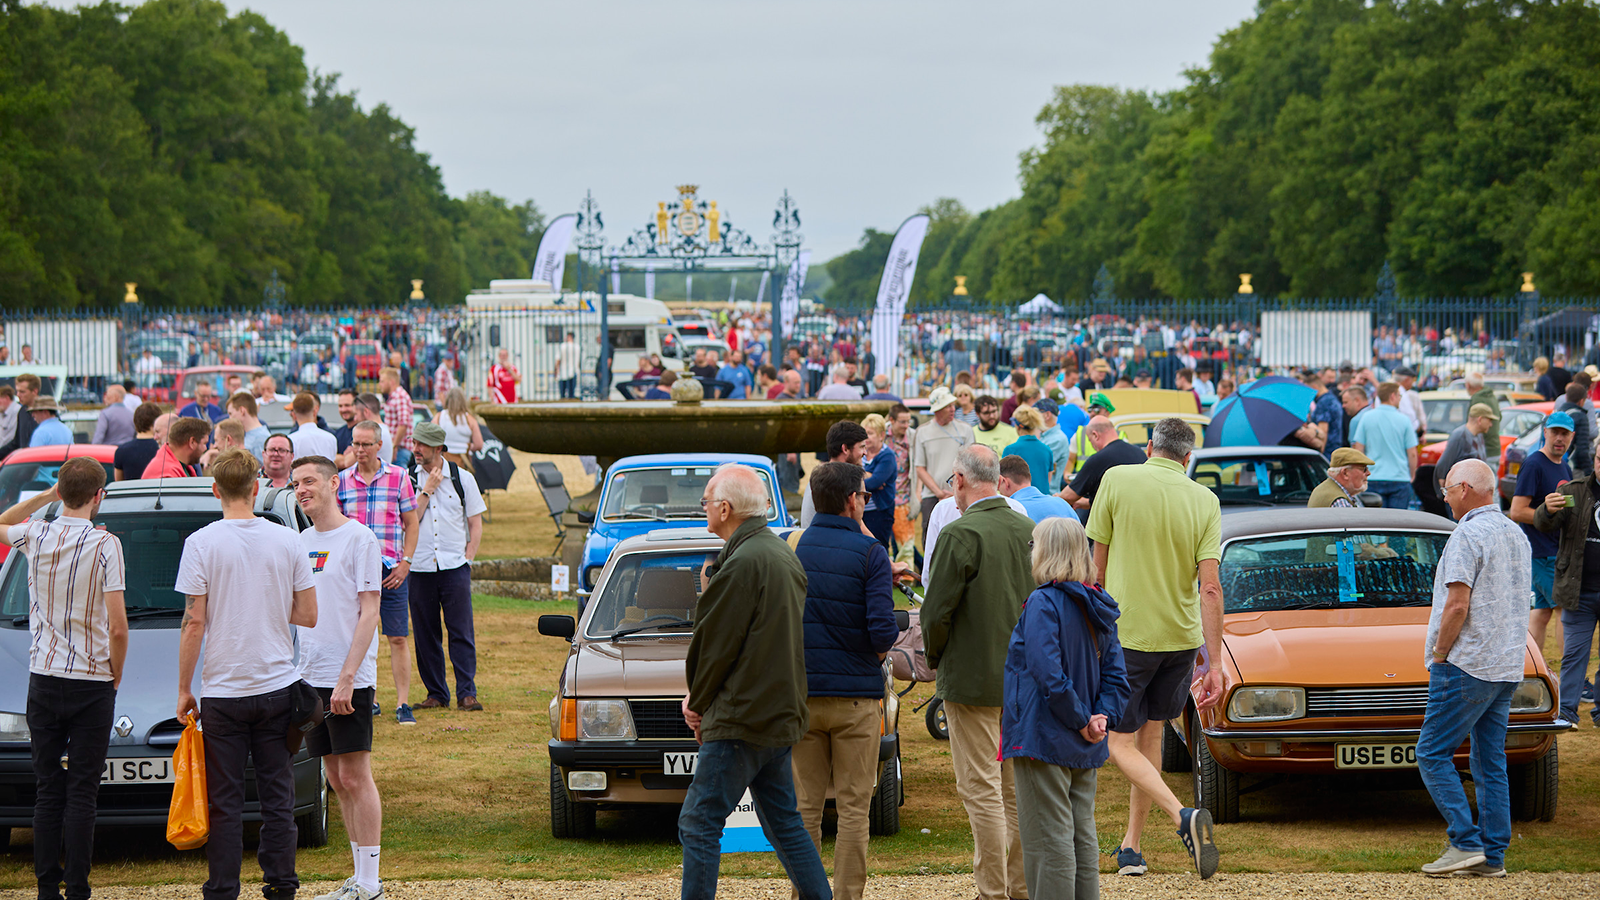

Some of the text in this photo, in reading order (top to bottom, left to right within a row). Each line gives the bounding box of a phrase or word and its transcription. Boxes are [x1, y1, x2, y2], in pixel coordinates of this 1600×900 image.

[665, 754, 697, 773] YV
[1342, 745, 1417, 765] USE 60
[122, 760, 168, 781] SCJ
